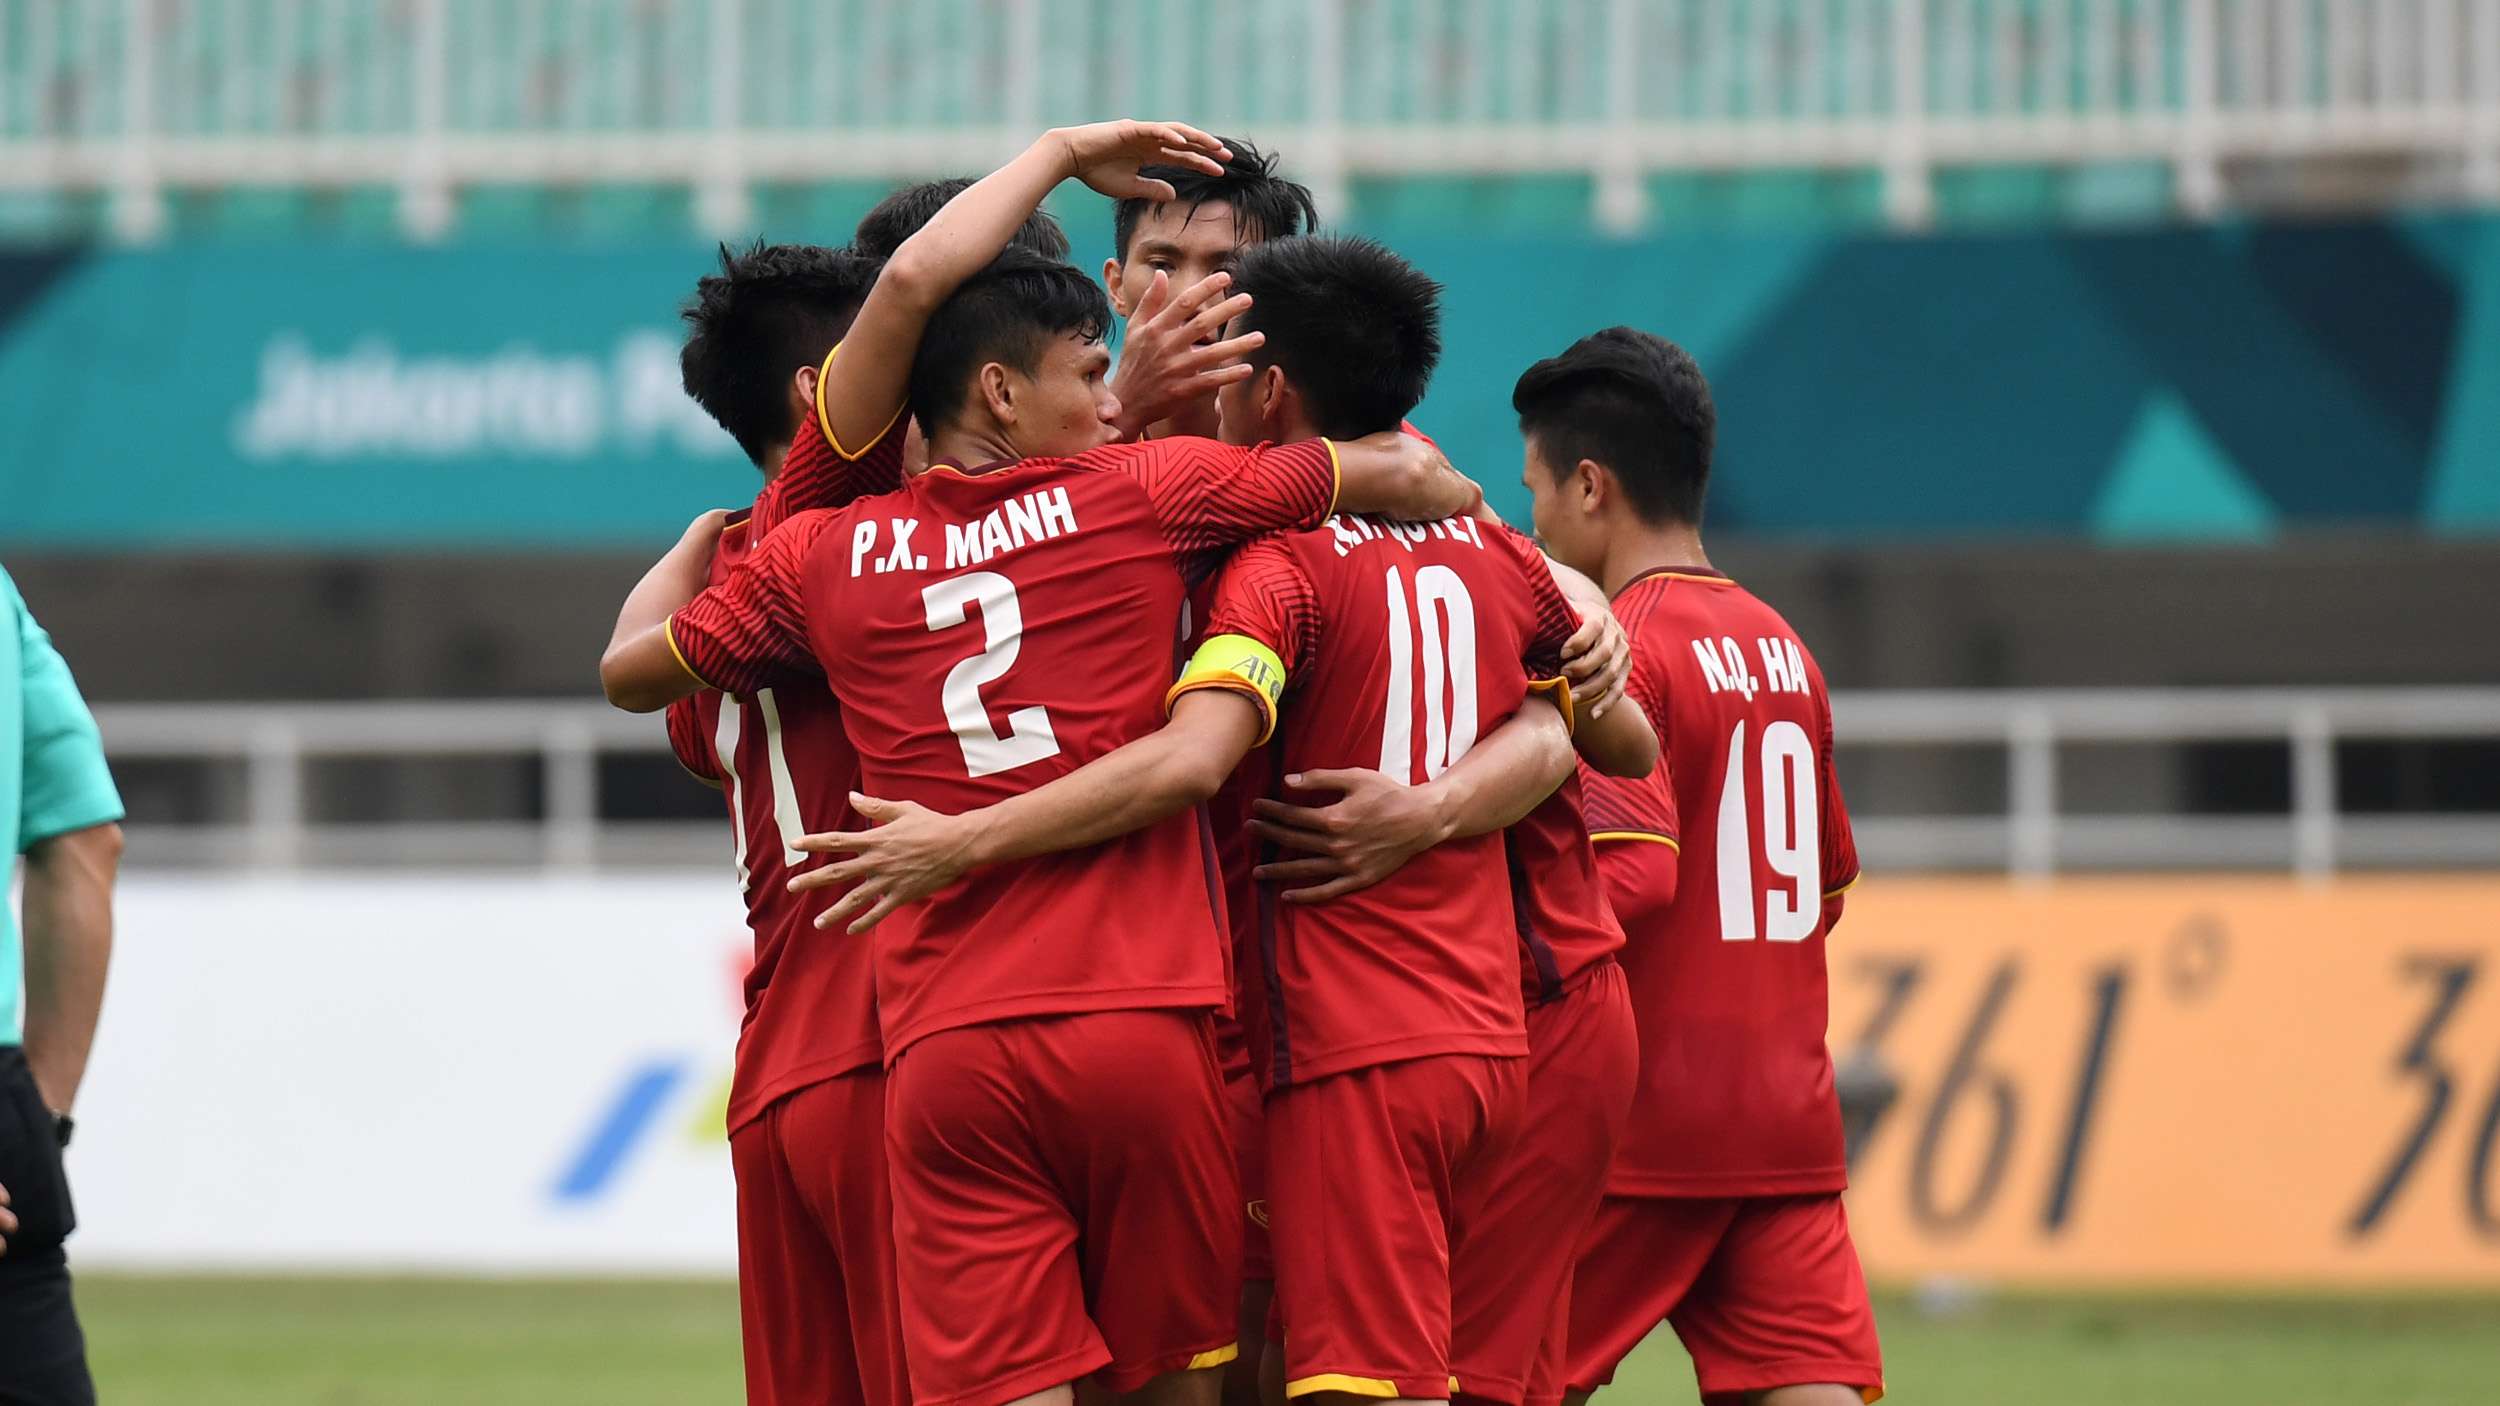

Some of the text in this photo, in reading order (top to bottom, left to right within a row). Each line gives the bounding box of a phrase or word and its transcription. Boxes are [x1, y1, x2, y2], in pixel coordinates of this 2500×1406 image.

[851, 486, 1078, 577] P.X. MANH
[921, 571, 1061, 778] 2
[1379, 564, 1478, 787] 10
[1691, 636, 1759, 702] N.Q.
[1717, 719, 1821, 941] 19
[2345, 950, 2500, 1245] 3
